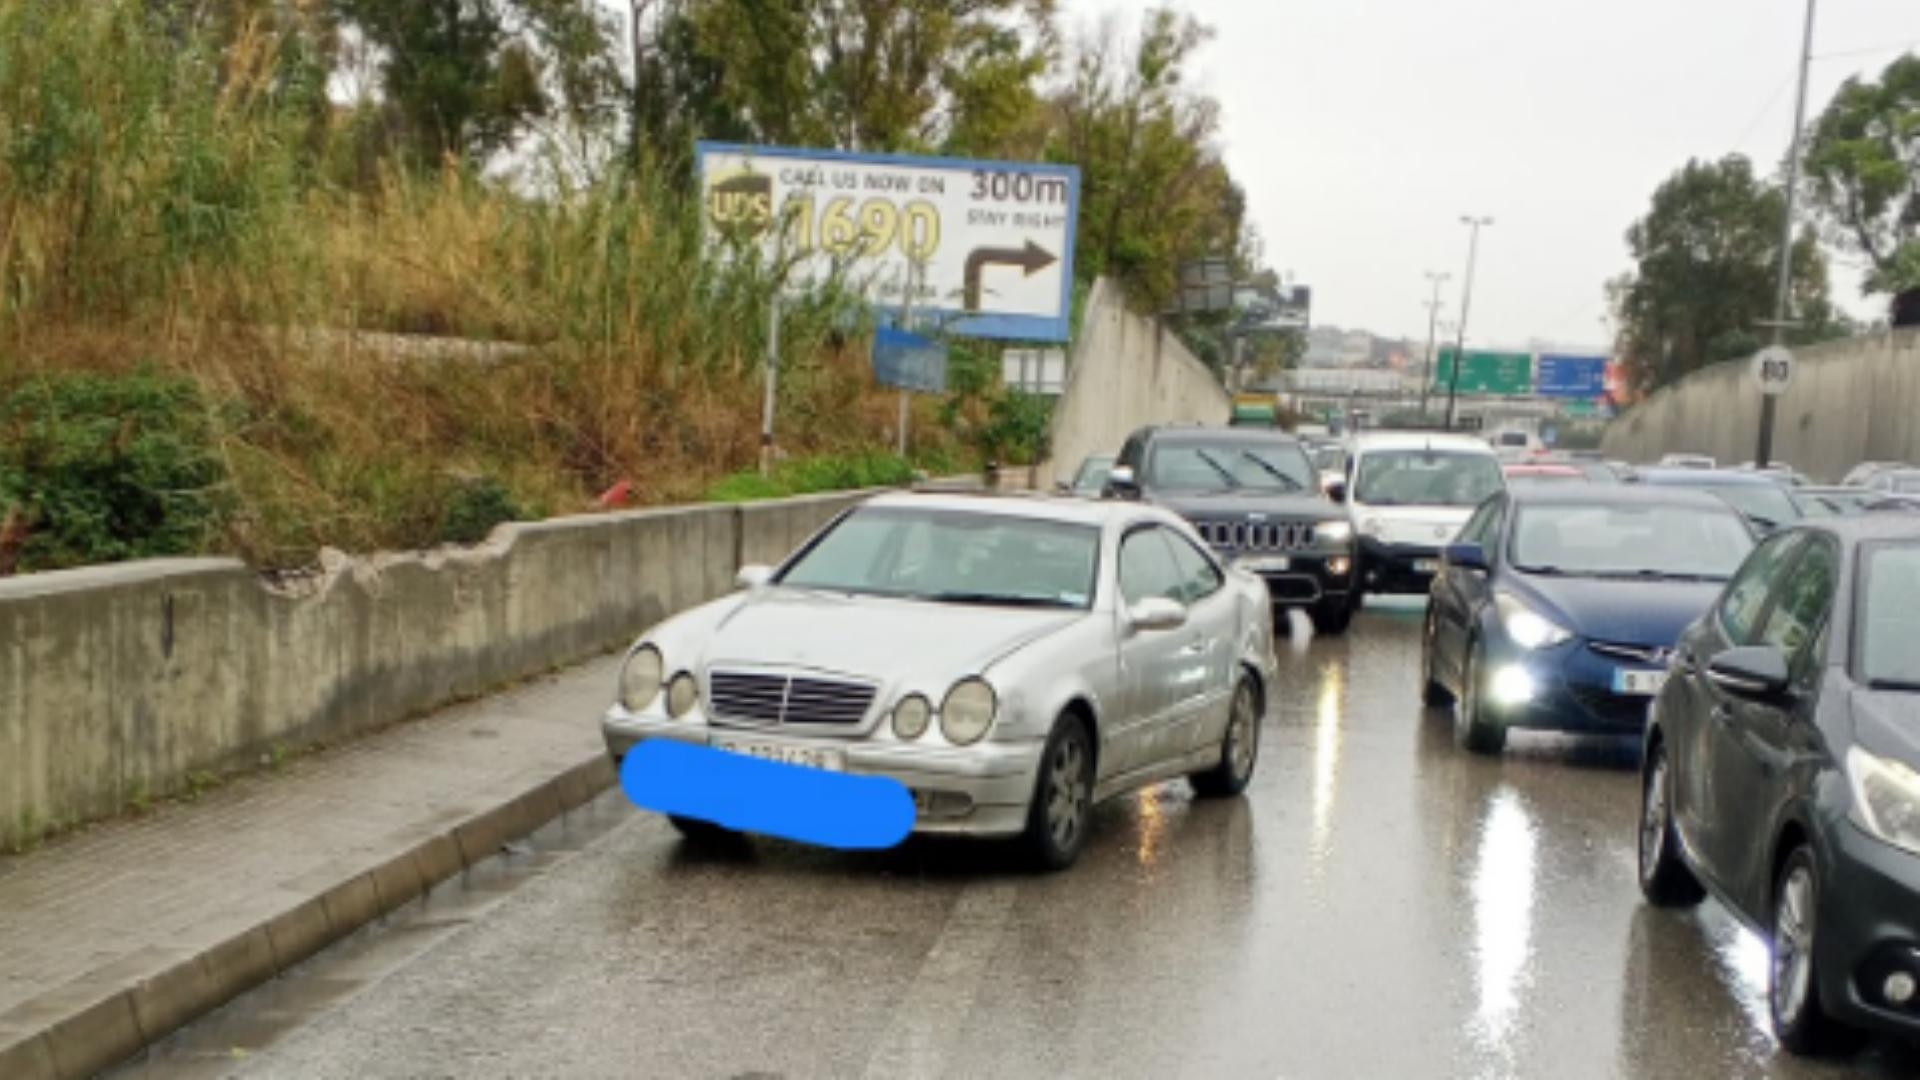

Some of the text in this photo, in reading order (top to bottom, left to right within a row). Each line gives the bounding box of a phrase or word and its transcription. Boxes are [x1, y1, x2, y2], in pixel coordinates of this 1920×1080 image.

[830, 170, 857, 190] US
[863, 172, 911, 193] NOW
[917, 175, 945, 195] ON
[968, 169, 1066, 204] 300m
[712, 190, 768, 223] UPS
[966, 208, 1008, 226] STAY
[784, 195, 942, 260] 1690
